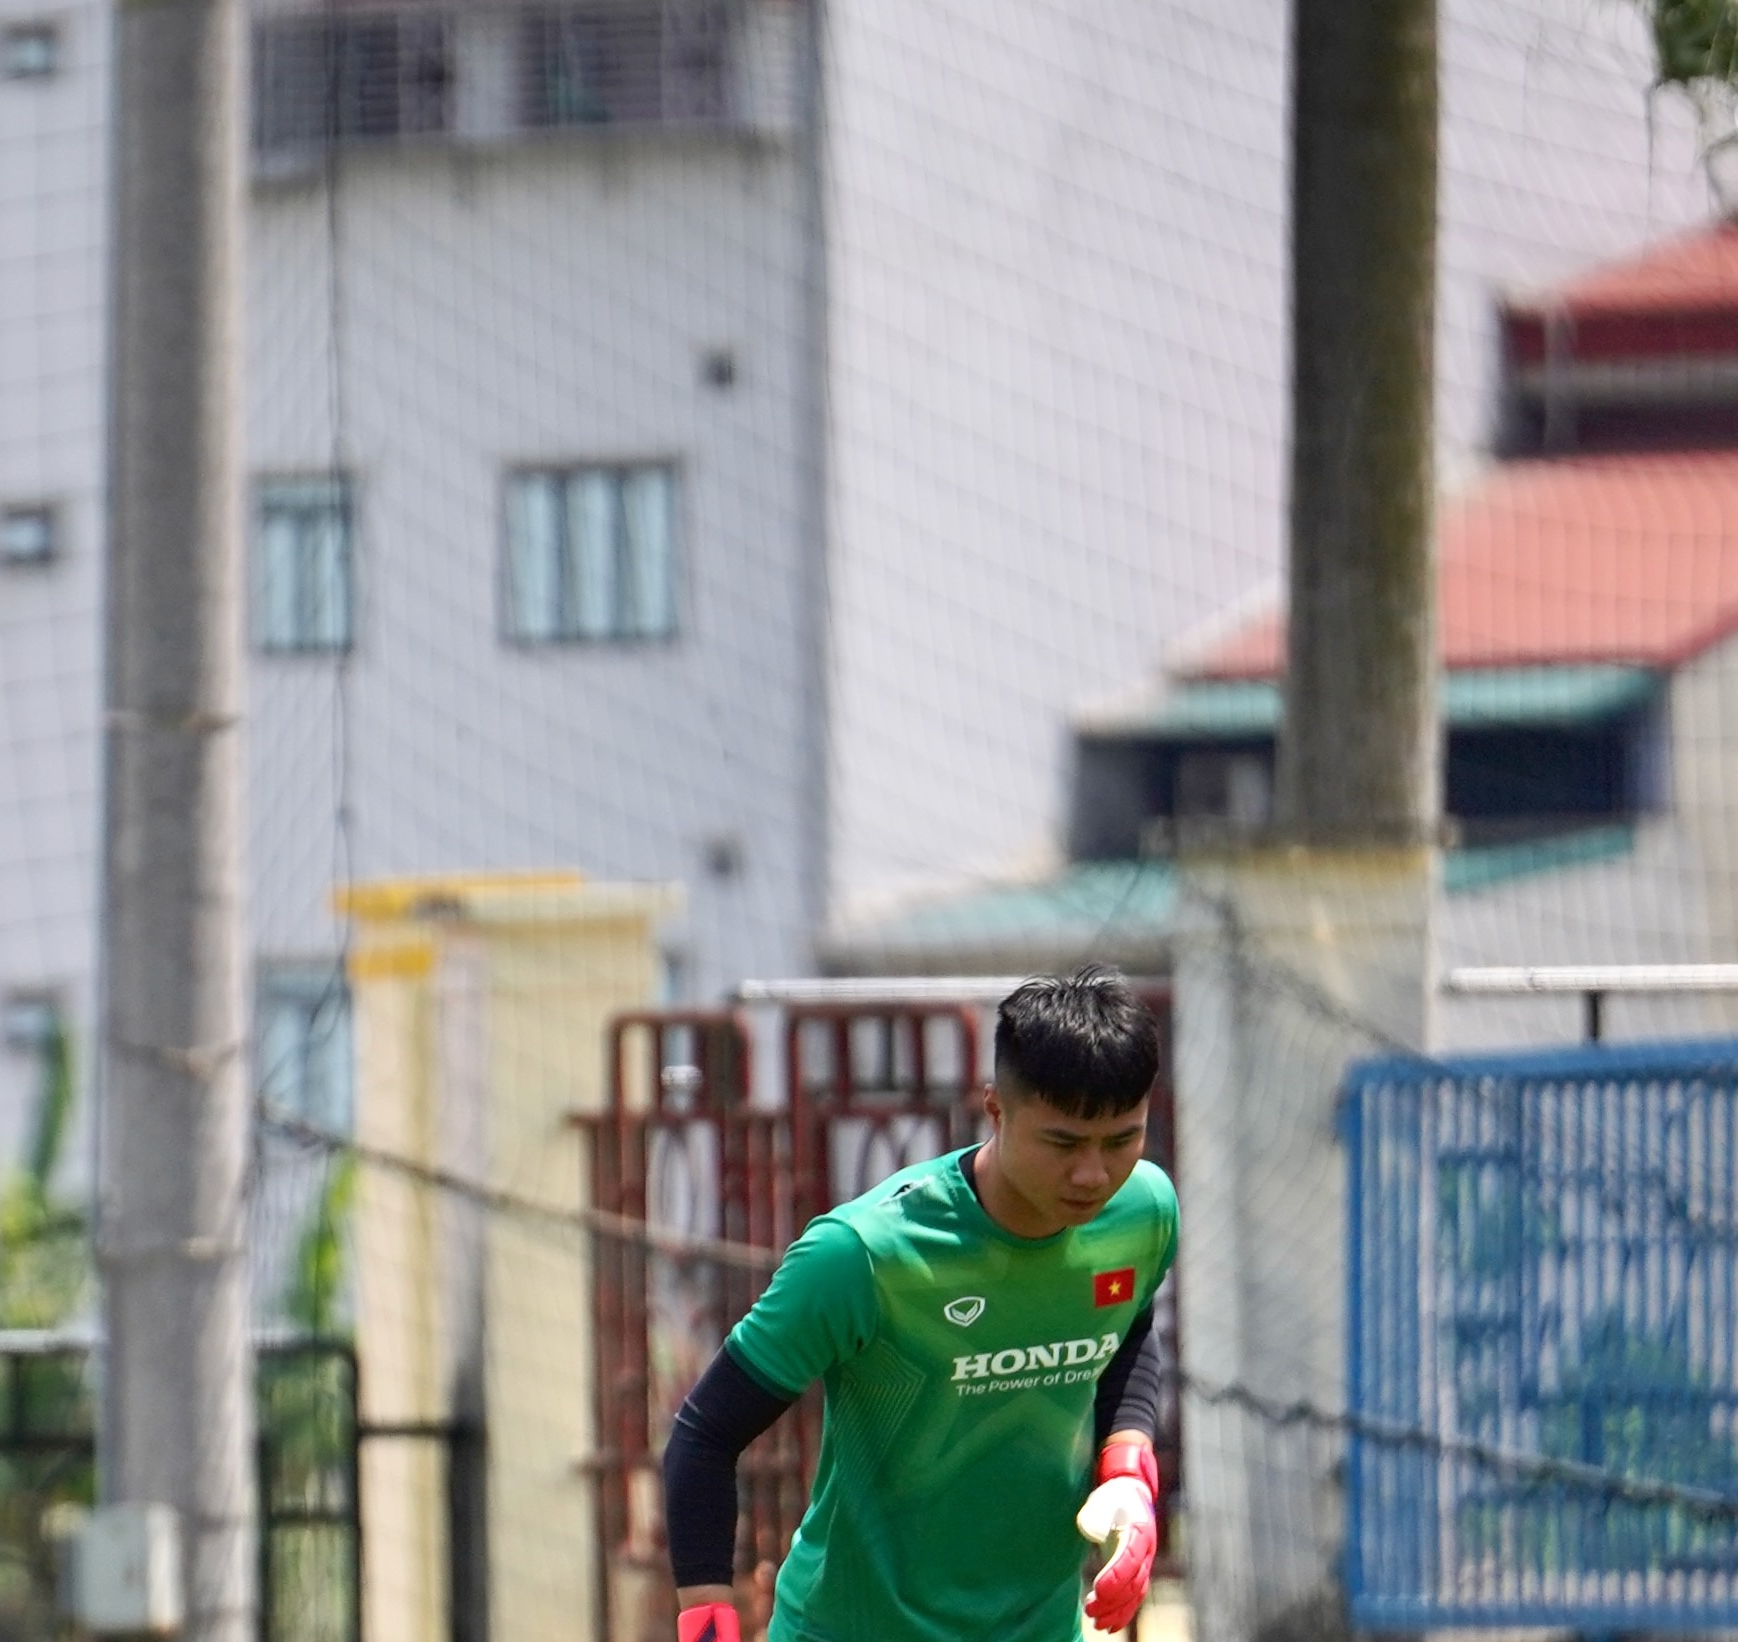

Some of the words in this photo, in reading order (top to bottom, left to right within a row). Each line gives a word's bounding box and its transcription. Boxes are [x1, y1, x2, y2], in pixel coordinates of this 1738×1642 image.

[950, 1332, 1120, 1381] HONDA
[956, 1383, 987, 1397] The
[988, 1375, 1040, 1392] Power
[1043, 1373, 1062, 1385] of
